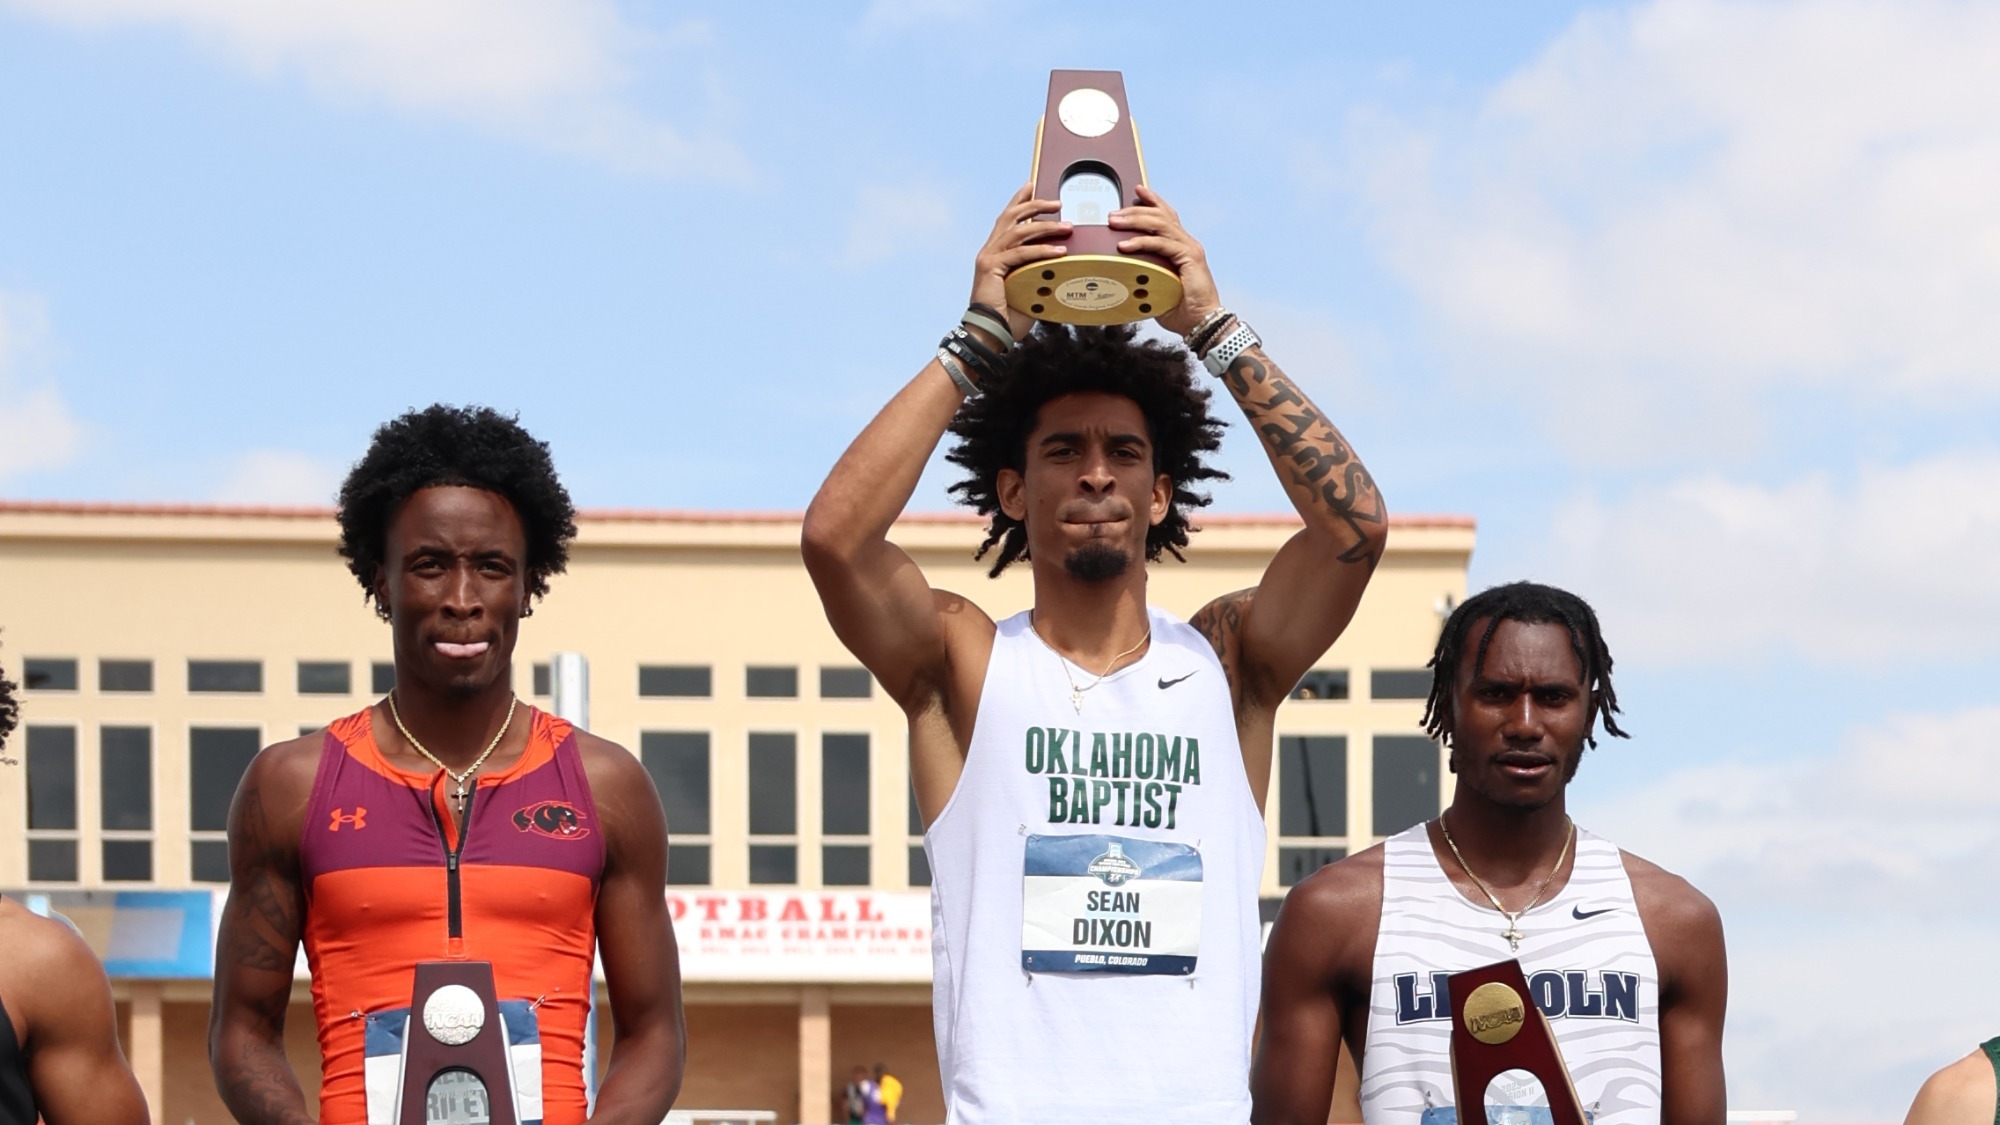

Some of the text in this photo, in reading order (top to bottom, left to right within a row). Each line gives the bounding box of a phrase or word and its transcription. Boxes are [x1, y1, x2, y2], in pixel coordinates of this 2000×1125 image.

[1026, 726, 1200, 785] OKLAHOMA
[1048, 776, 1182, 830] BAPTIST
[1086, 890, 1140, 914] SEAN
[782, 926, 932, 941] CHAMPIONS
[1072, 918, 1152, 948] DIXON
[1074, 954, 1148, 967] PUEBLO, COLORADO
[1393, 970, 1640, 1025] LIOLN
[429, 1013, 483, 1031] NCAA
